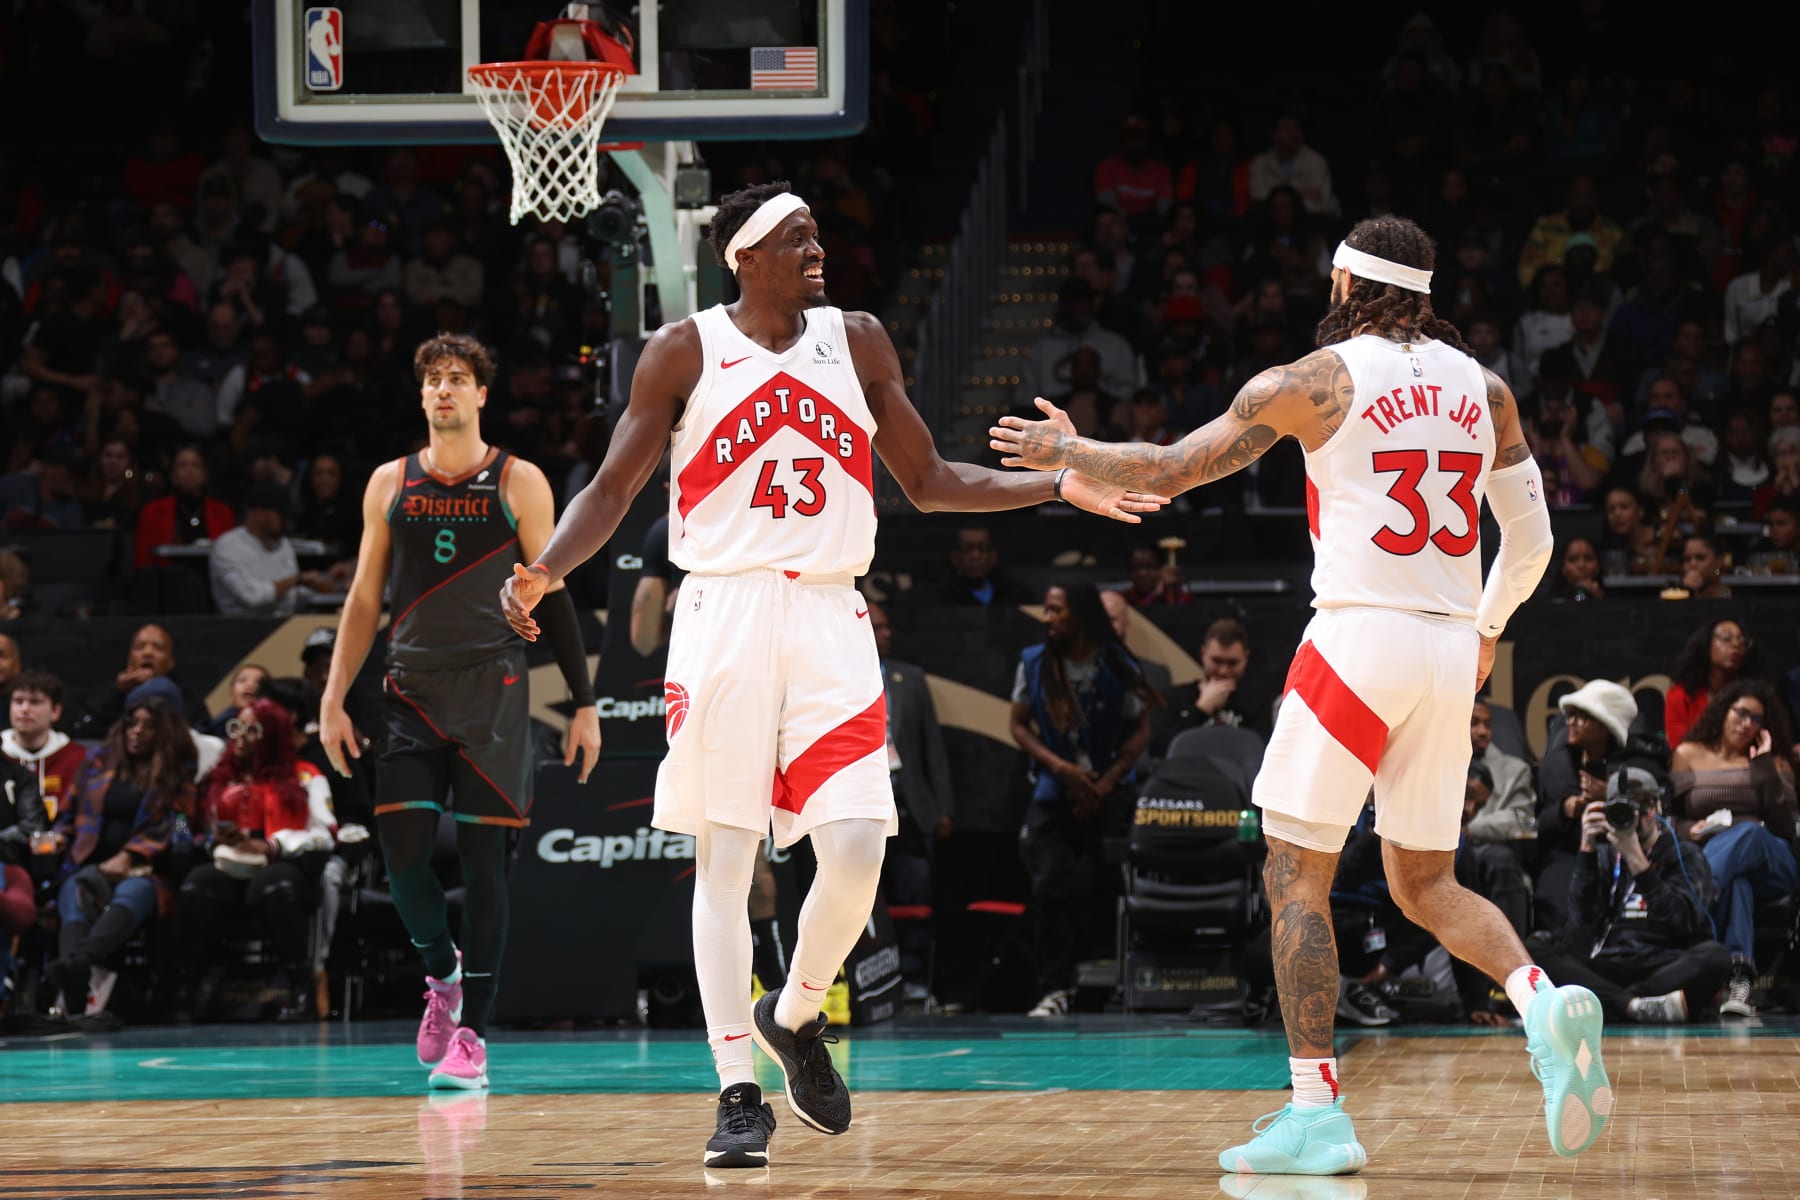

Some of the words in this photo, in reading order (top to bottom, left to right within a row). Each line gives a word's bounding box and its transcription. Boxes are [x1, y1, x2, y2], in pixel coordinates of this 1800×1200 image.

[812, 357, 826, 365] Sun
[827, 357, 840, 365] Life
[715, 388, 853, 464] RAPTORS
[1361, 384, 1442, 435] TRENT
[1449, 394, 1482, 440] JR.
[404, 493, 490, 516] District
[750, 457, 827, 519] 43
[1371, 449, 1484, 557] 33
[434, 529, 456, 563] 8
[1136, 796, 1204, 811] CAESARS
